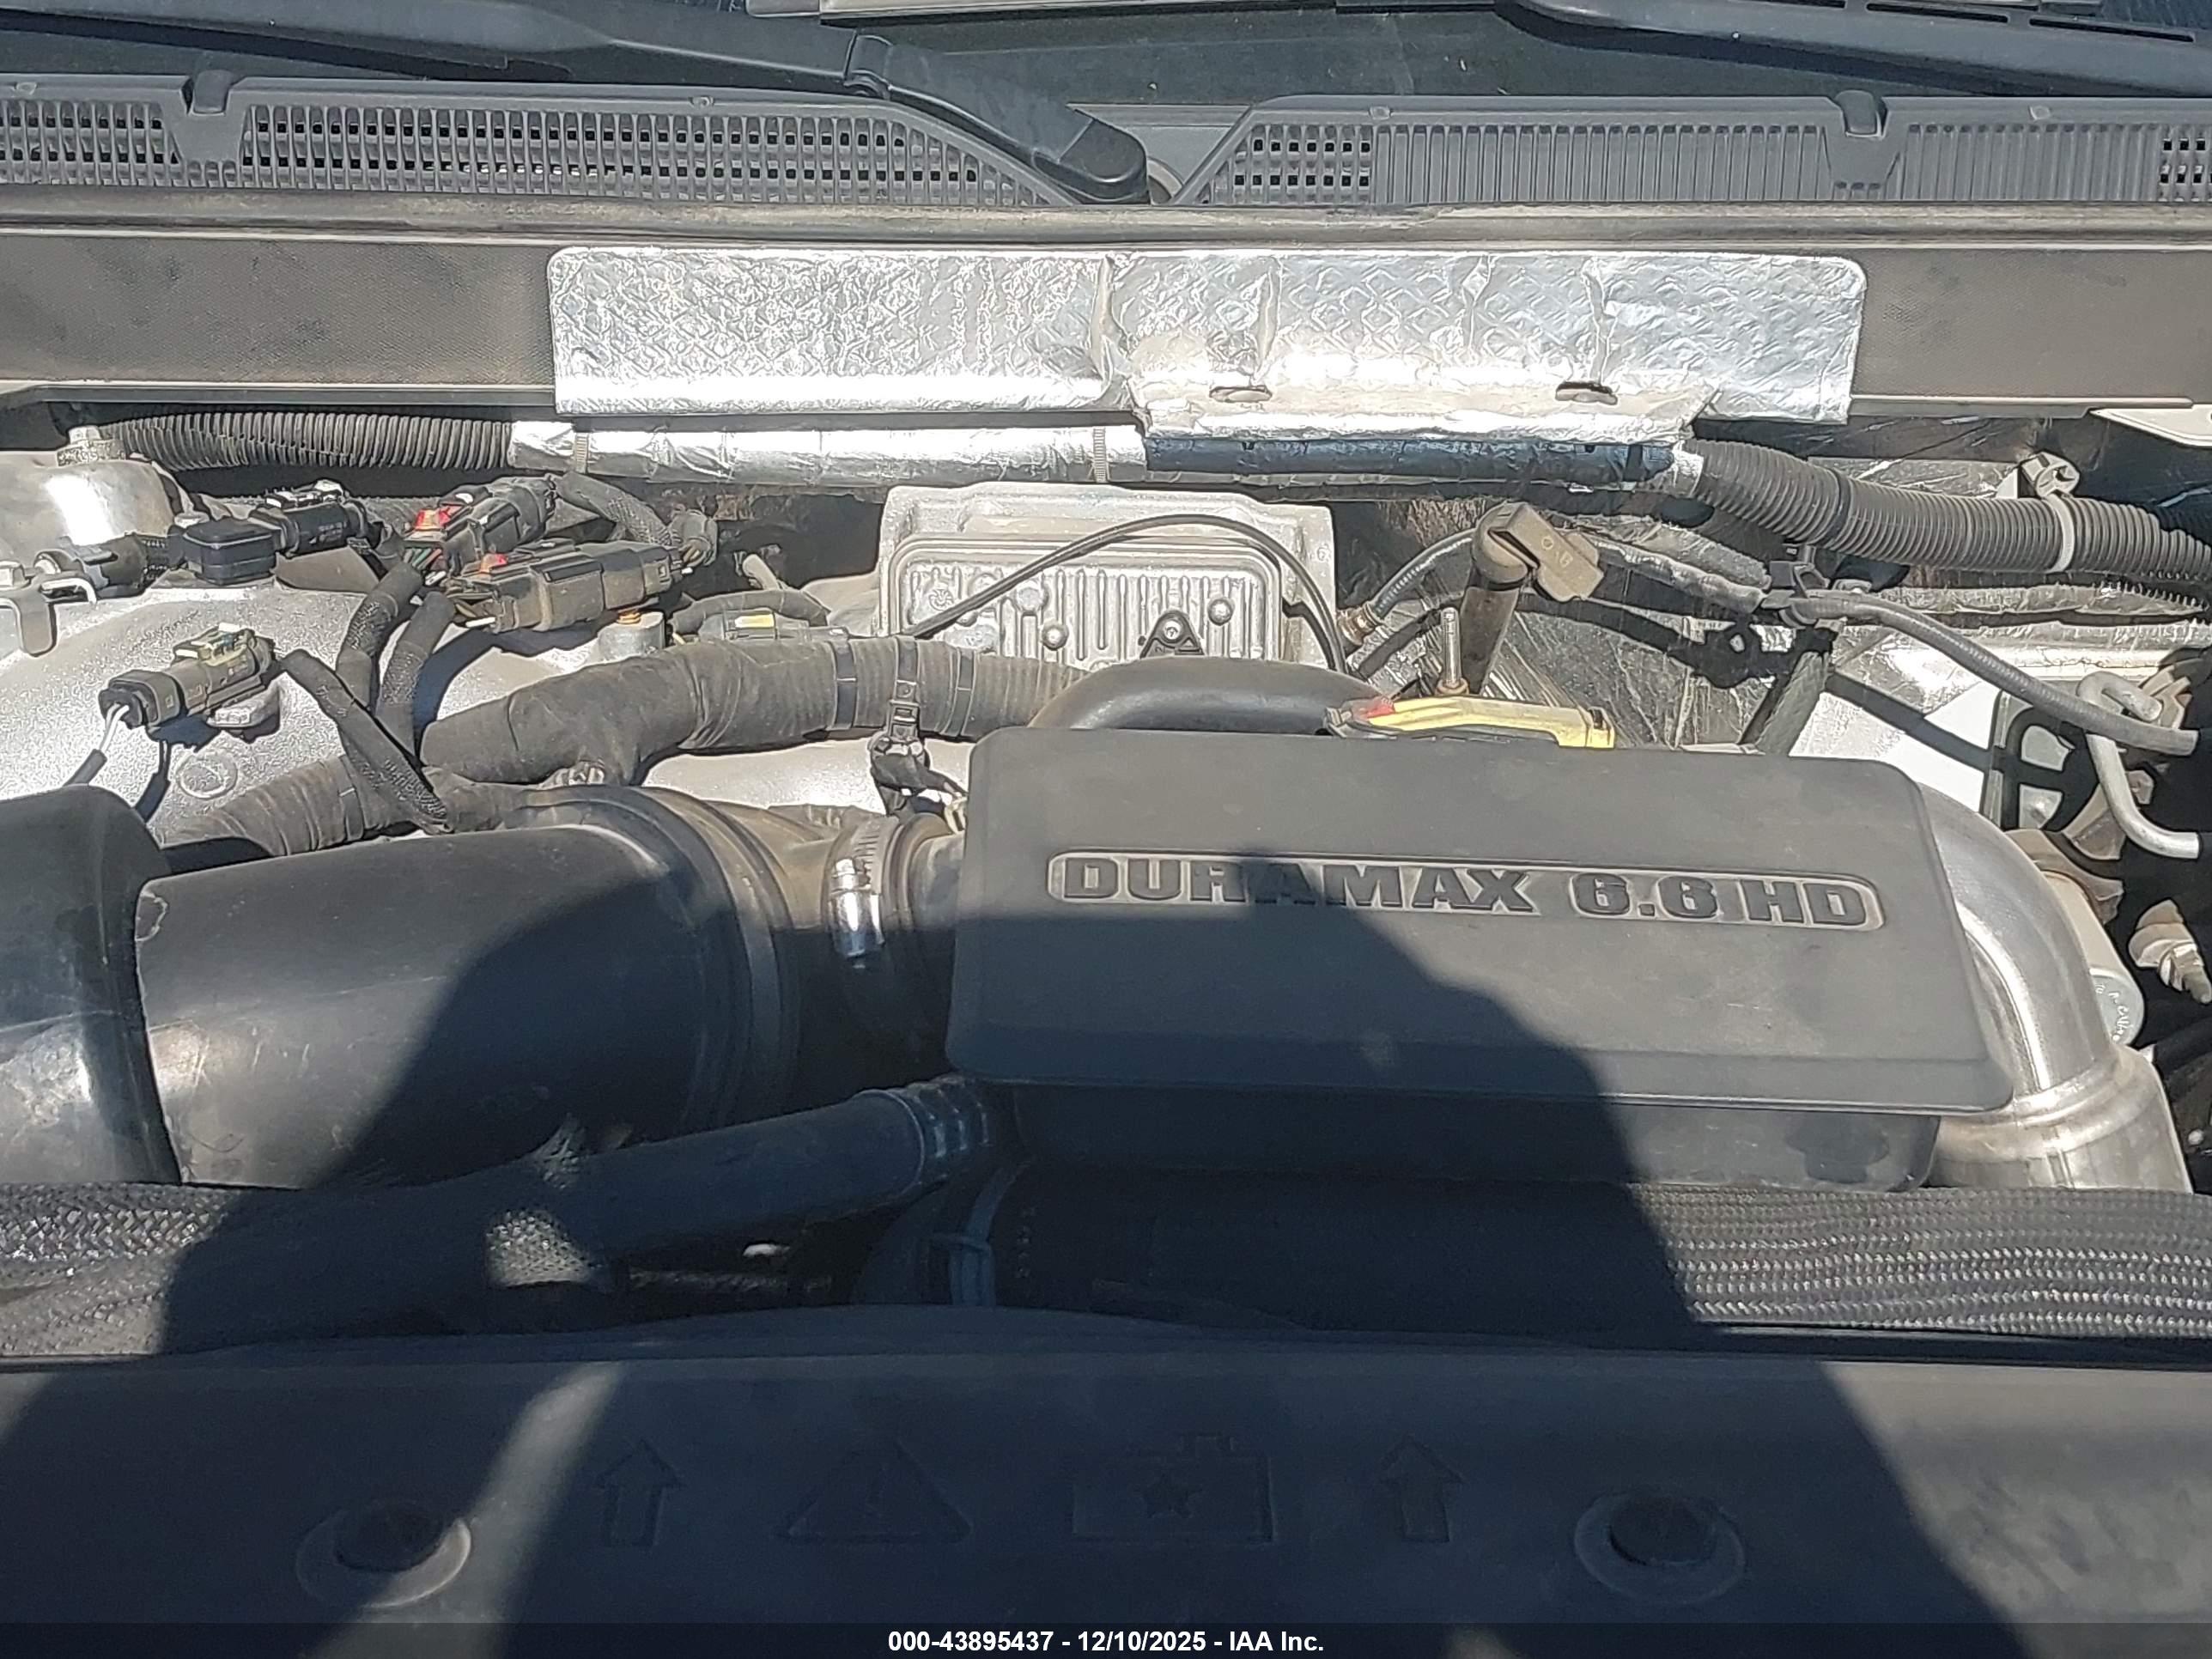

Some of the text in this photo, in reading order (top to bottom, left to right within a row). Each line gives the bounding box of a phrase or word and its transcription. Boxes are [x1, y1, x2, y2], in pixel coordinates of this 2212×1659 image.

[1062, 856, 1869, 927] DURAMAX 6.6 HD
